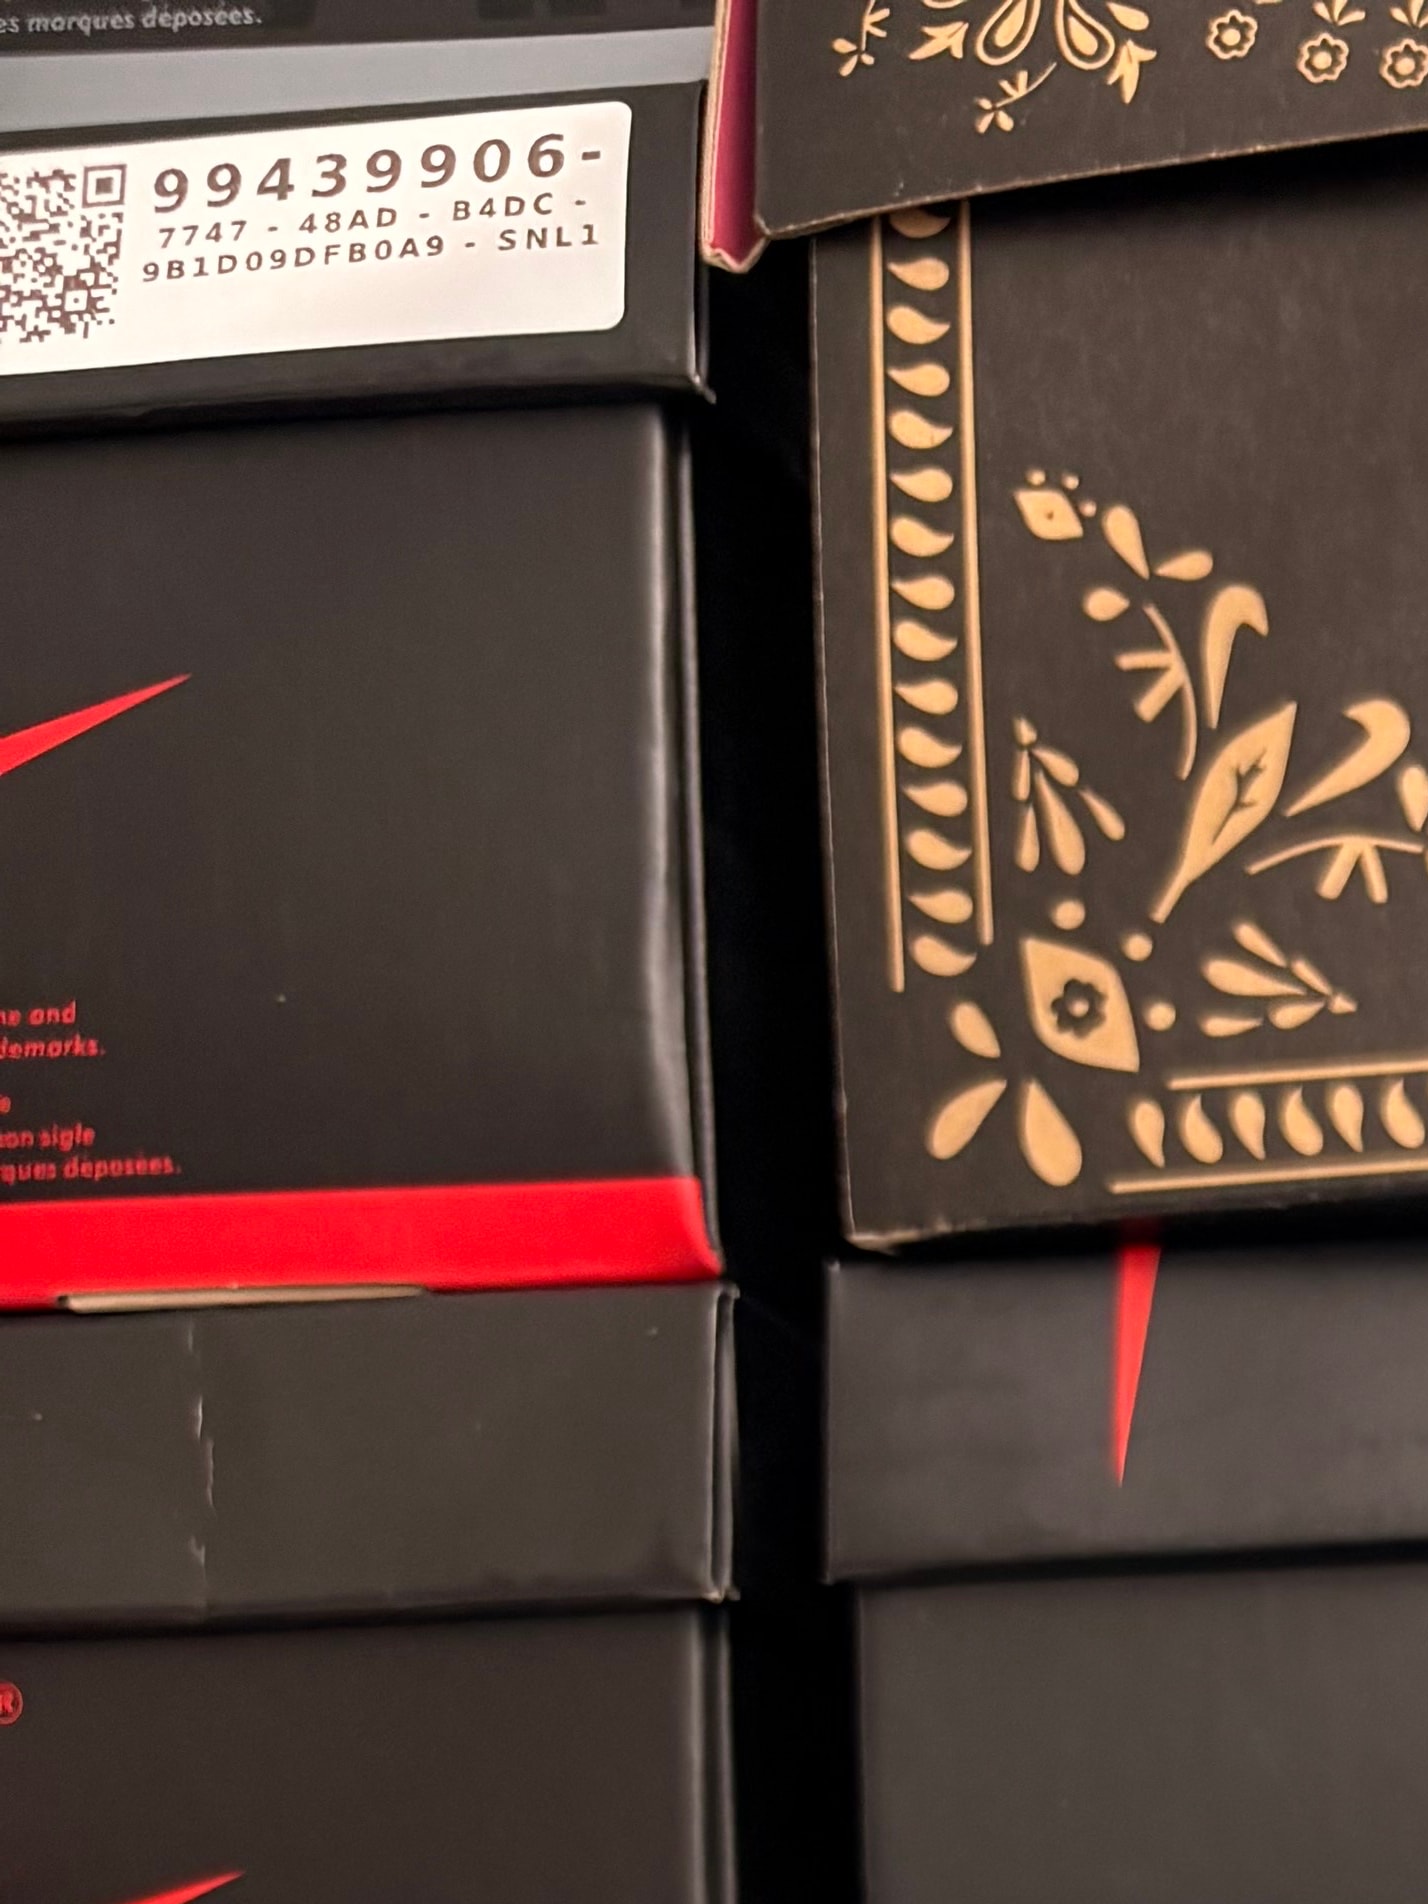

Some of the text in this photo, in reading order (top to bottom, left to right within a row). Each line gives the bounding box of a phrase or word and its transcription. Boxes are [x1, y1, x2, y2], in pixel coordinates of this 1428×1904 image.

[27, 12, 135, 37] marques
[153, 132, 602, 213] 99439906-
[28, 1000, 76, 1026] and
[39, 1122, 95, 1151] sigle
